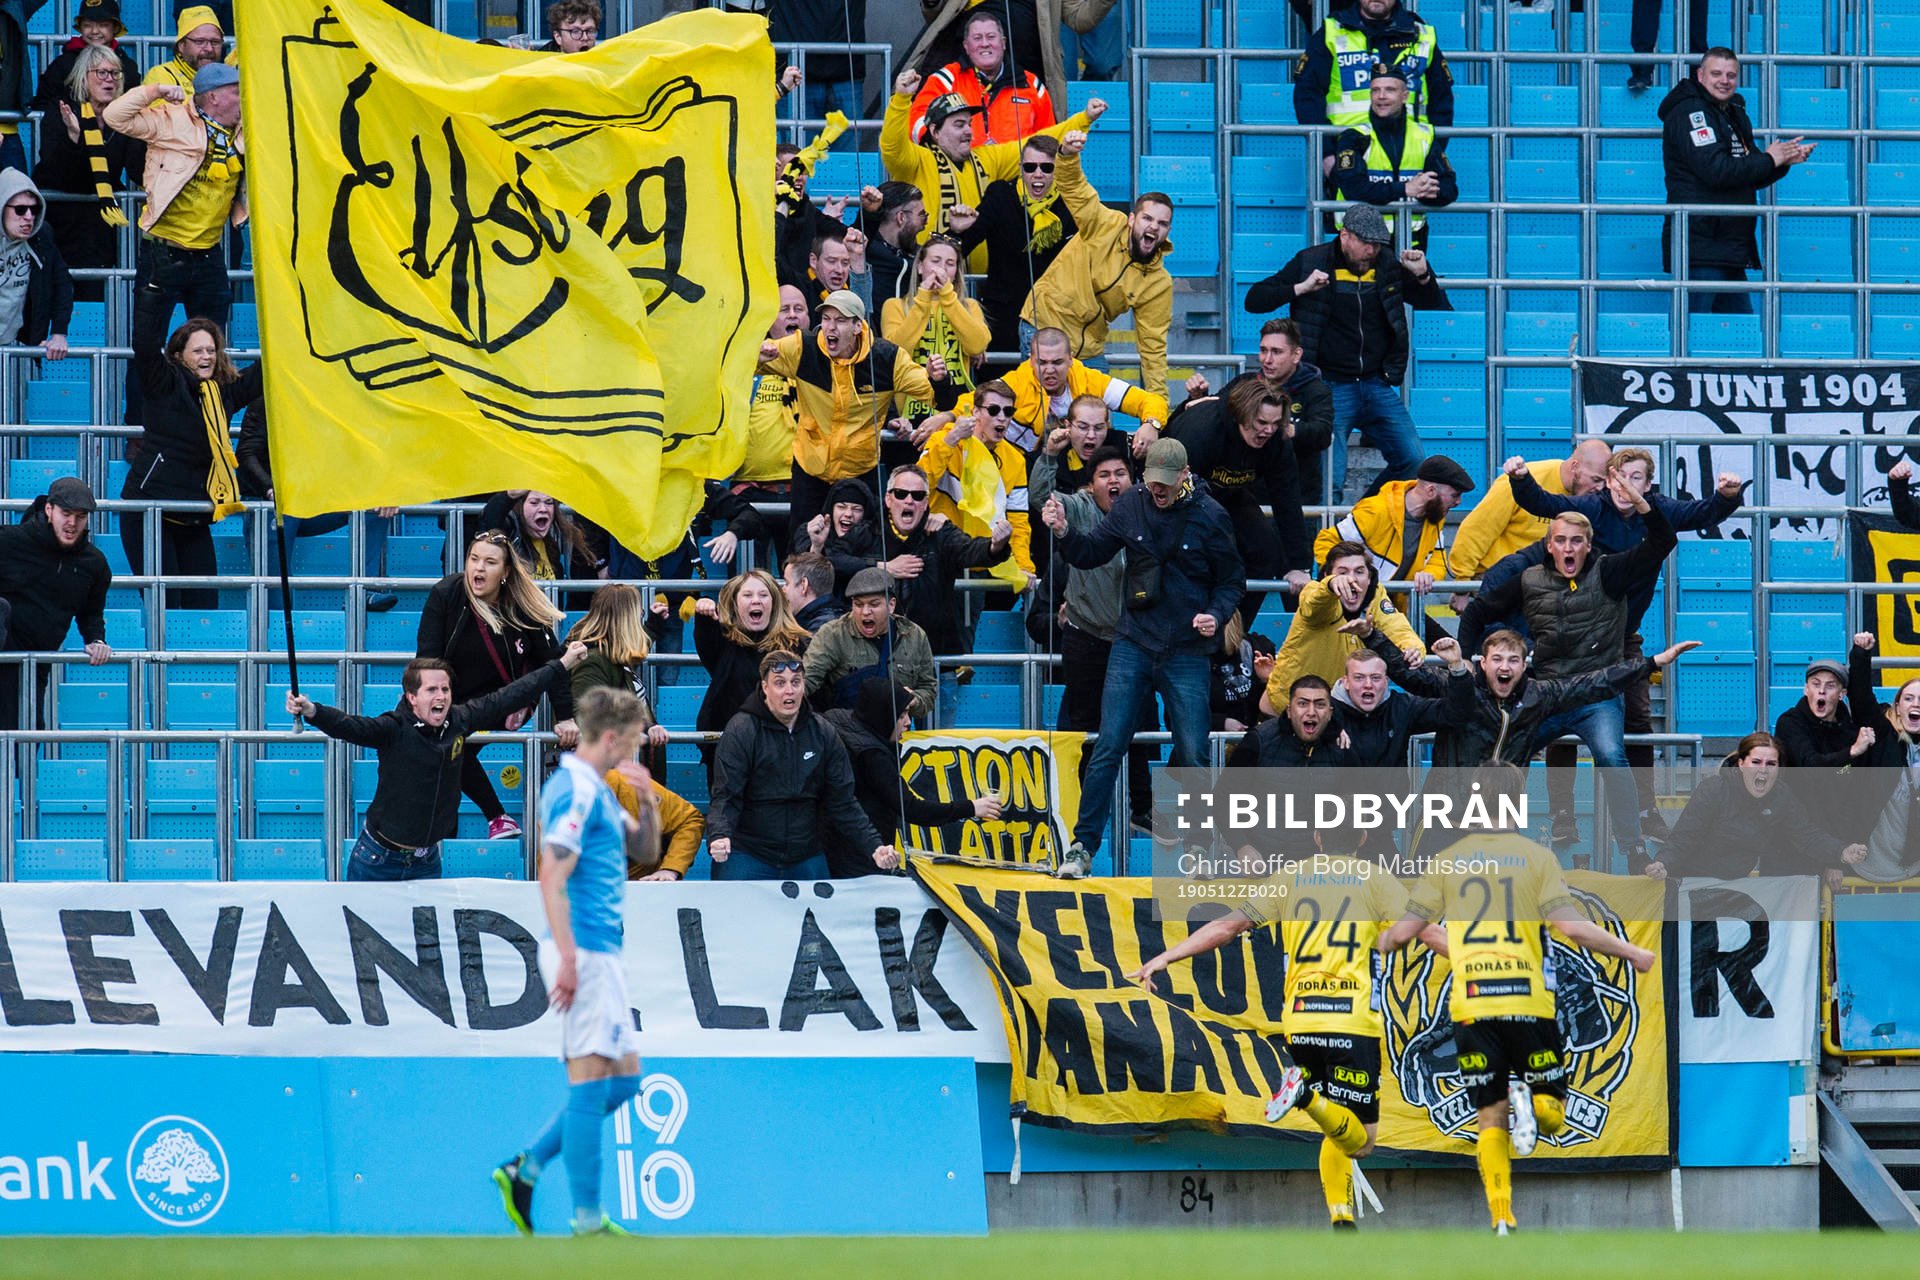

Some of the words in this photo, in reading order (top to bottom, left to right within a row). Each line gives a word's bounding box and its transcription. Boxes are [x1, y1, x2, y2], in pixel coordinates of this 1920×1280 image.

[1621, 369, 1676, 404] 26
[1687, 372, 1788, 408] JUNI
[1800, 372, 1907, 407] 1904
[1294, 895, 1361, 964] 24
[1459, 876, 1524, 945] 21
[0, 901, 550, 1031] LEVAND
[1297, 979, 1337, 991] BORÅS
[1340, 980, 1361, 991] BIL
[1465, 959, 1512, 973] BORÅS
[1329, 1037, 1353, 1049] BYGG
[1336, 1068, 1367, 1086] EAB
[147, 1192, 184, 1216] SINCE
[187, 1192, 212, 1214] 1820
[617, 1150, 696, 1220] 10
[1180, 1175, 1214, 1213] 84
